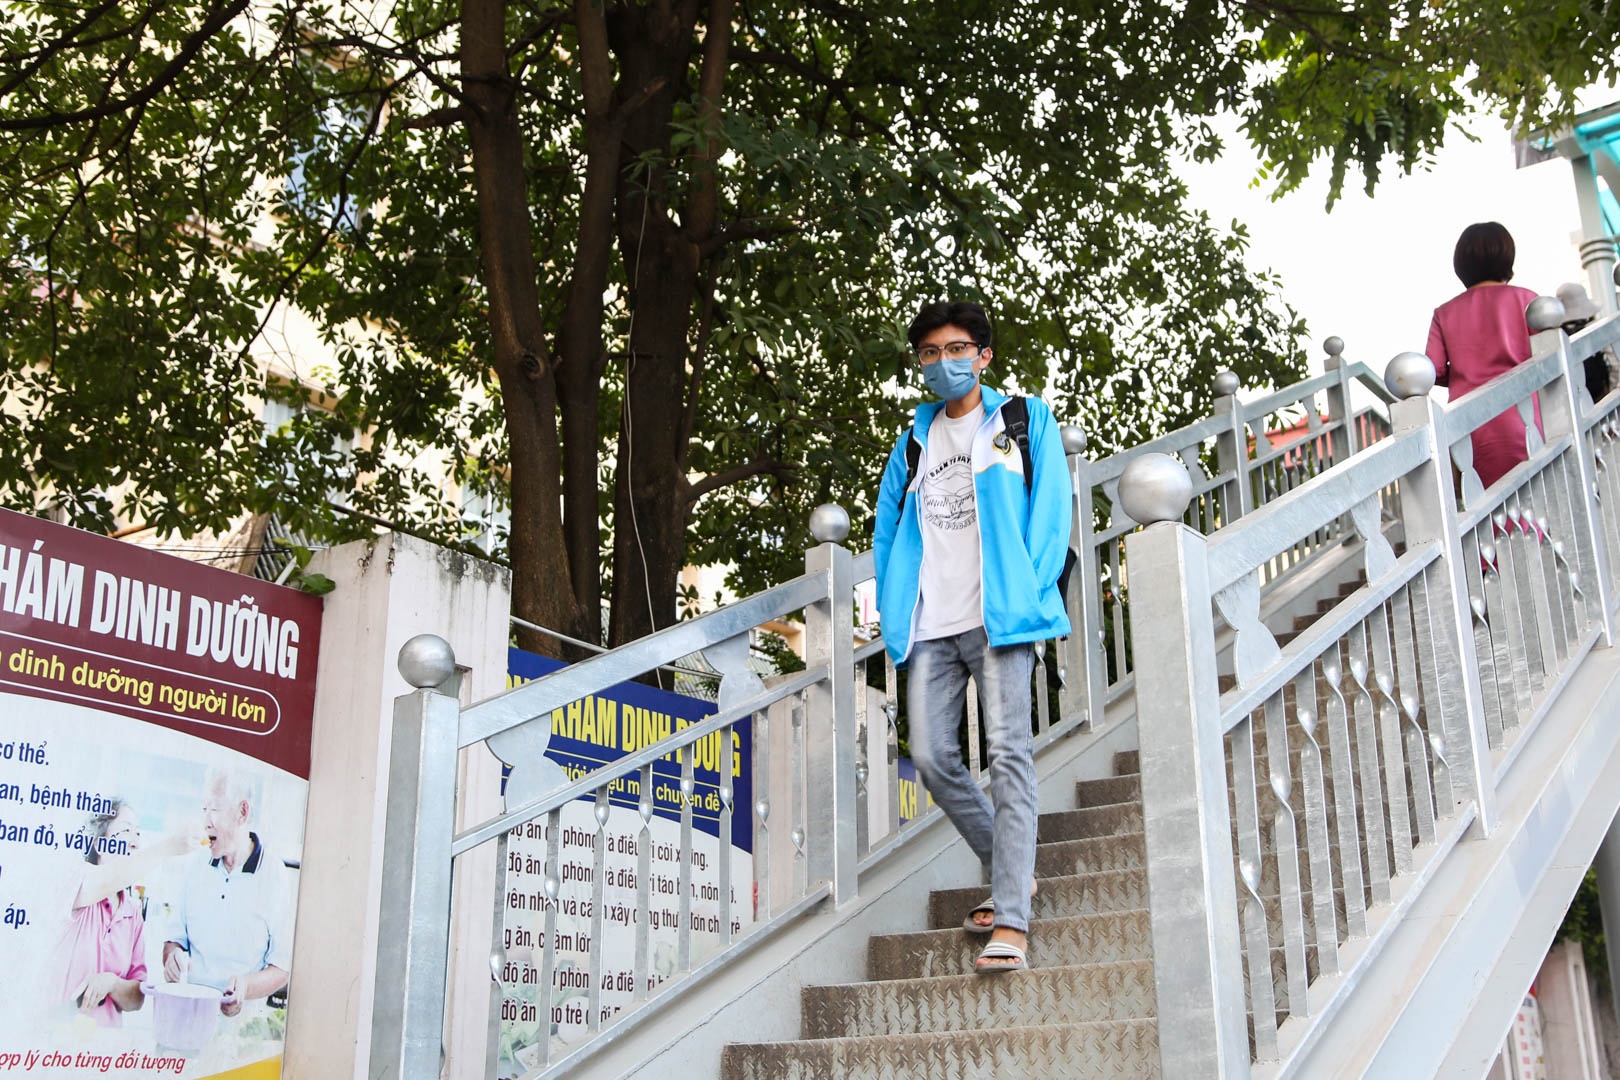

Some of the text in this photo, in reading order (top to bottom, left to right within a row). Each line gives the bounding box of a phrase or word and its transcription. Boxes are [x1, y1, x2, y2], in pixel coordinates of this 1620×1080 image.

[90, 570, 181, 651] DINH
[186, 594, 300, 680] DƯỠNG
[9, 648, 65, 681] dinh
[71, 662, 154, 705] dưỡng
[159, 684, 228, 714] người
[231, 695, 266, 723] lớn
[19, 741, 49, 766] thể.
[30, 783, 72, 810] bệnh
[76, 791, 116, 817] thận.
[704, 790, 720, 811] đề
[33, 823, 59, 850] đỏ,
[65, 826, 95, 855] vẩy
[97, 834, 131, 856] nến.
[658, 841, 673, 862] còi
[525, 855, 541, 875] ăn
[657, 874, 674, 895] táo
[701, 881, 719, 902] nôn
[4, 902, 30, 930] áp.
[563, 895, 577, 916] và
[610, 901, 630, 927] xây
[515, 925, 535, 951] ăn,
[502, 961, 518, 988] độ
[522, 963, 538, 984] ăn
[559, 966, 590, 992] phòn
[501, 999, 517, 1026] độ
[521, 999, 536, 1022] ăn
[566, 1002, 583, 1025] trẻ
[23, 1049, 40, 1071] lý
[41, 1051, 72, 1068] cho
[74, 1051, 113, 1072] từng
[115, 1049, 139, 1069] đối
[141, 1054, 186, 1074] tượng
